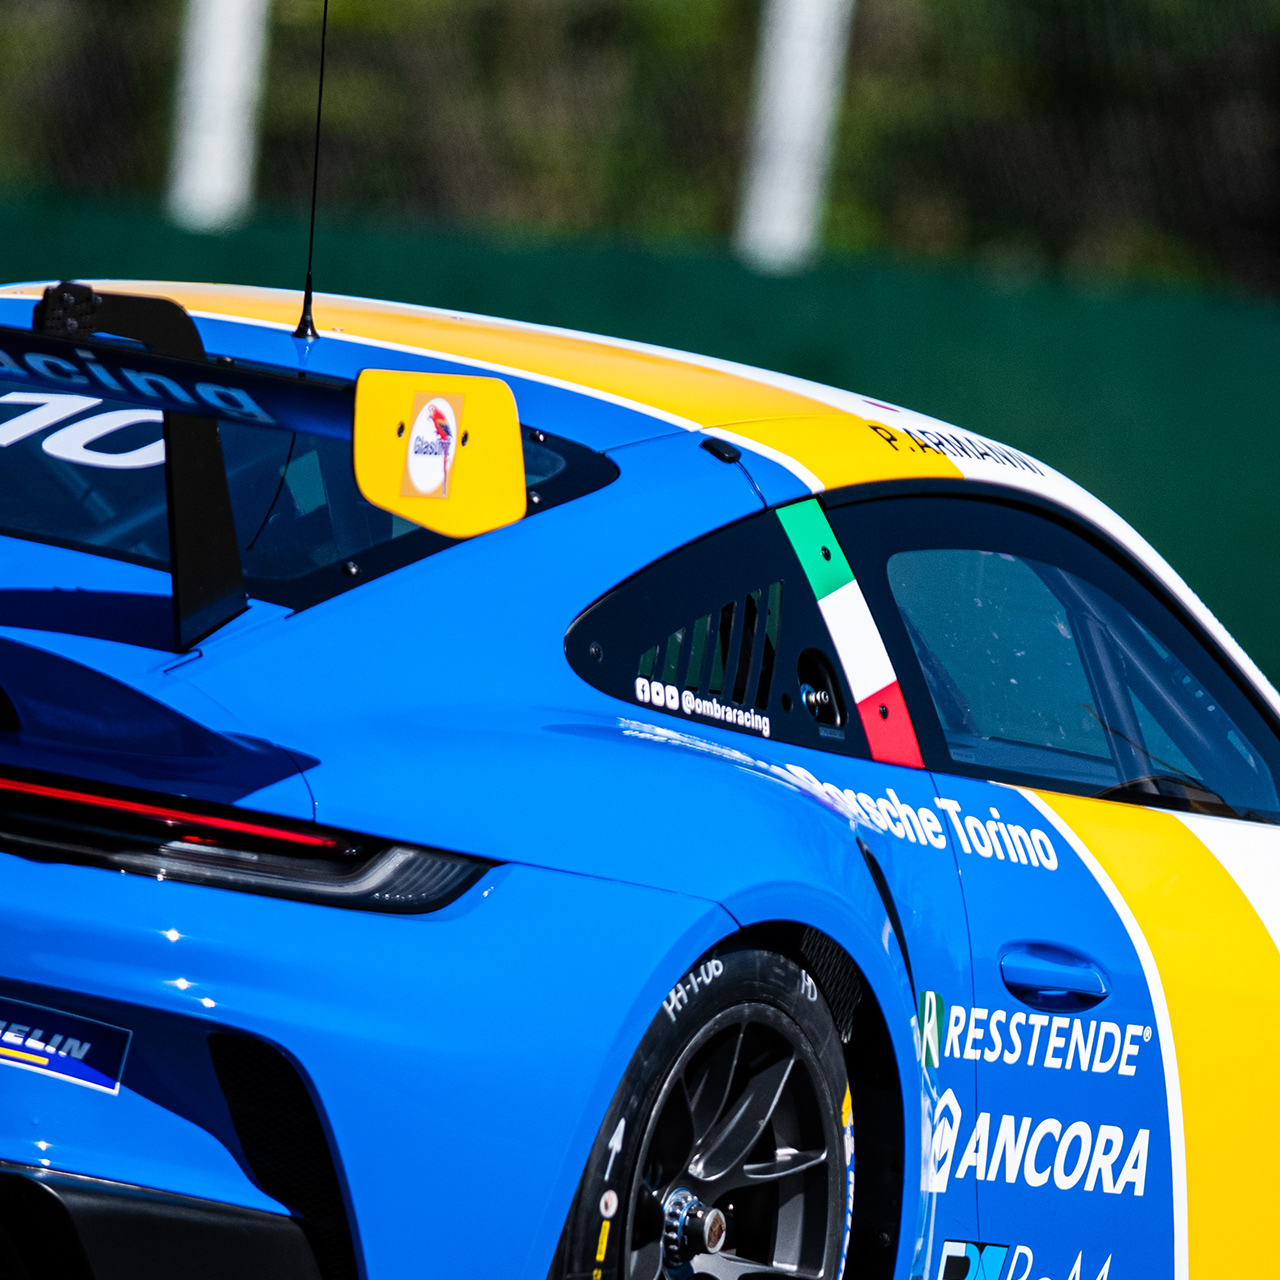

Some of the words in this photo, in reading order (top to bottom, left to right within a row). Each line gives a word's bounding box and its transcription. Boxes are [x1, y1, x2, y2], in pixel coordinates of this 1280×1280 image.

[681, 689, 771, 738] @ombraracing
[934, 795, 1059, 872] Torino
[955, 1111, 1151, 1197] ANCORA
